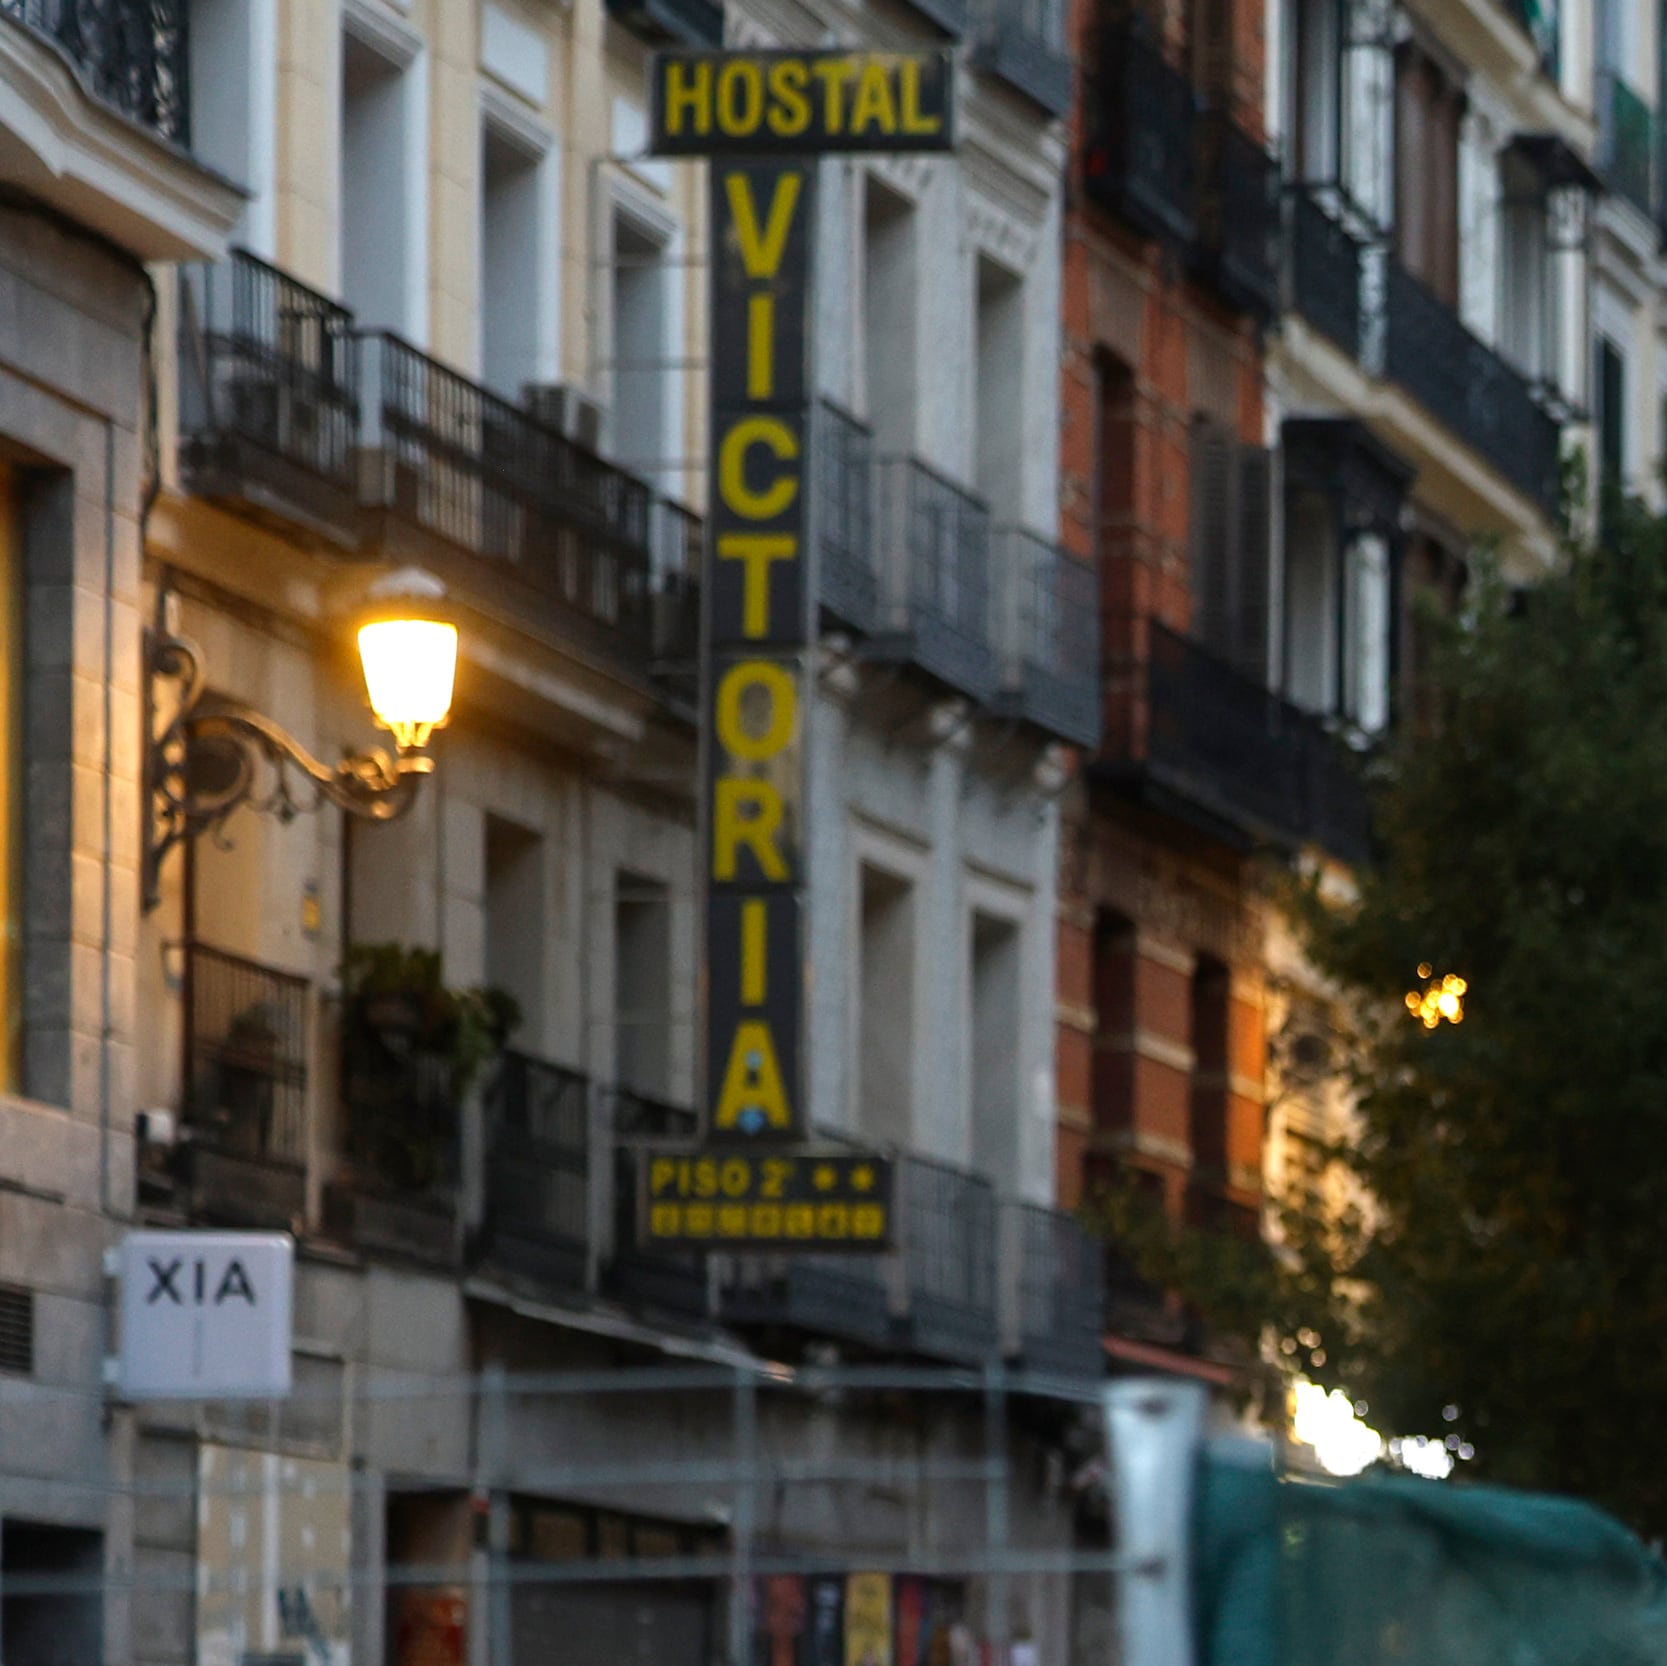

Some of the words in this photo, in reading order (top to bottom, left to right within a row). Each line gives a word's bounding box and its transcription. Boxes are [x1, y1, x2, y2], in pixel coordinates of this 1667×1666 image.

[664, 59, 942, 137] HOSTAL
[714, 171, 804, 1129] VICTORIA
[651, 1157, 750, 1198] PISO
[147, 1257, 257, 1306] XIA
